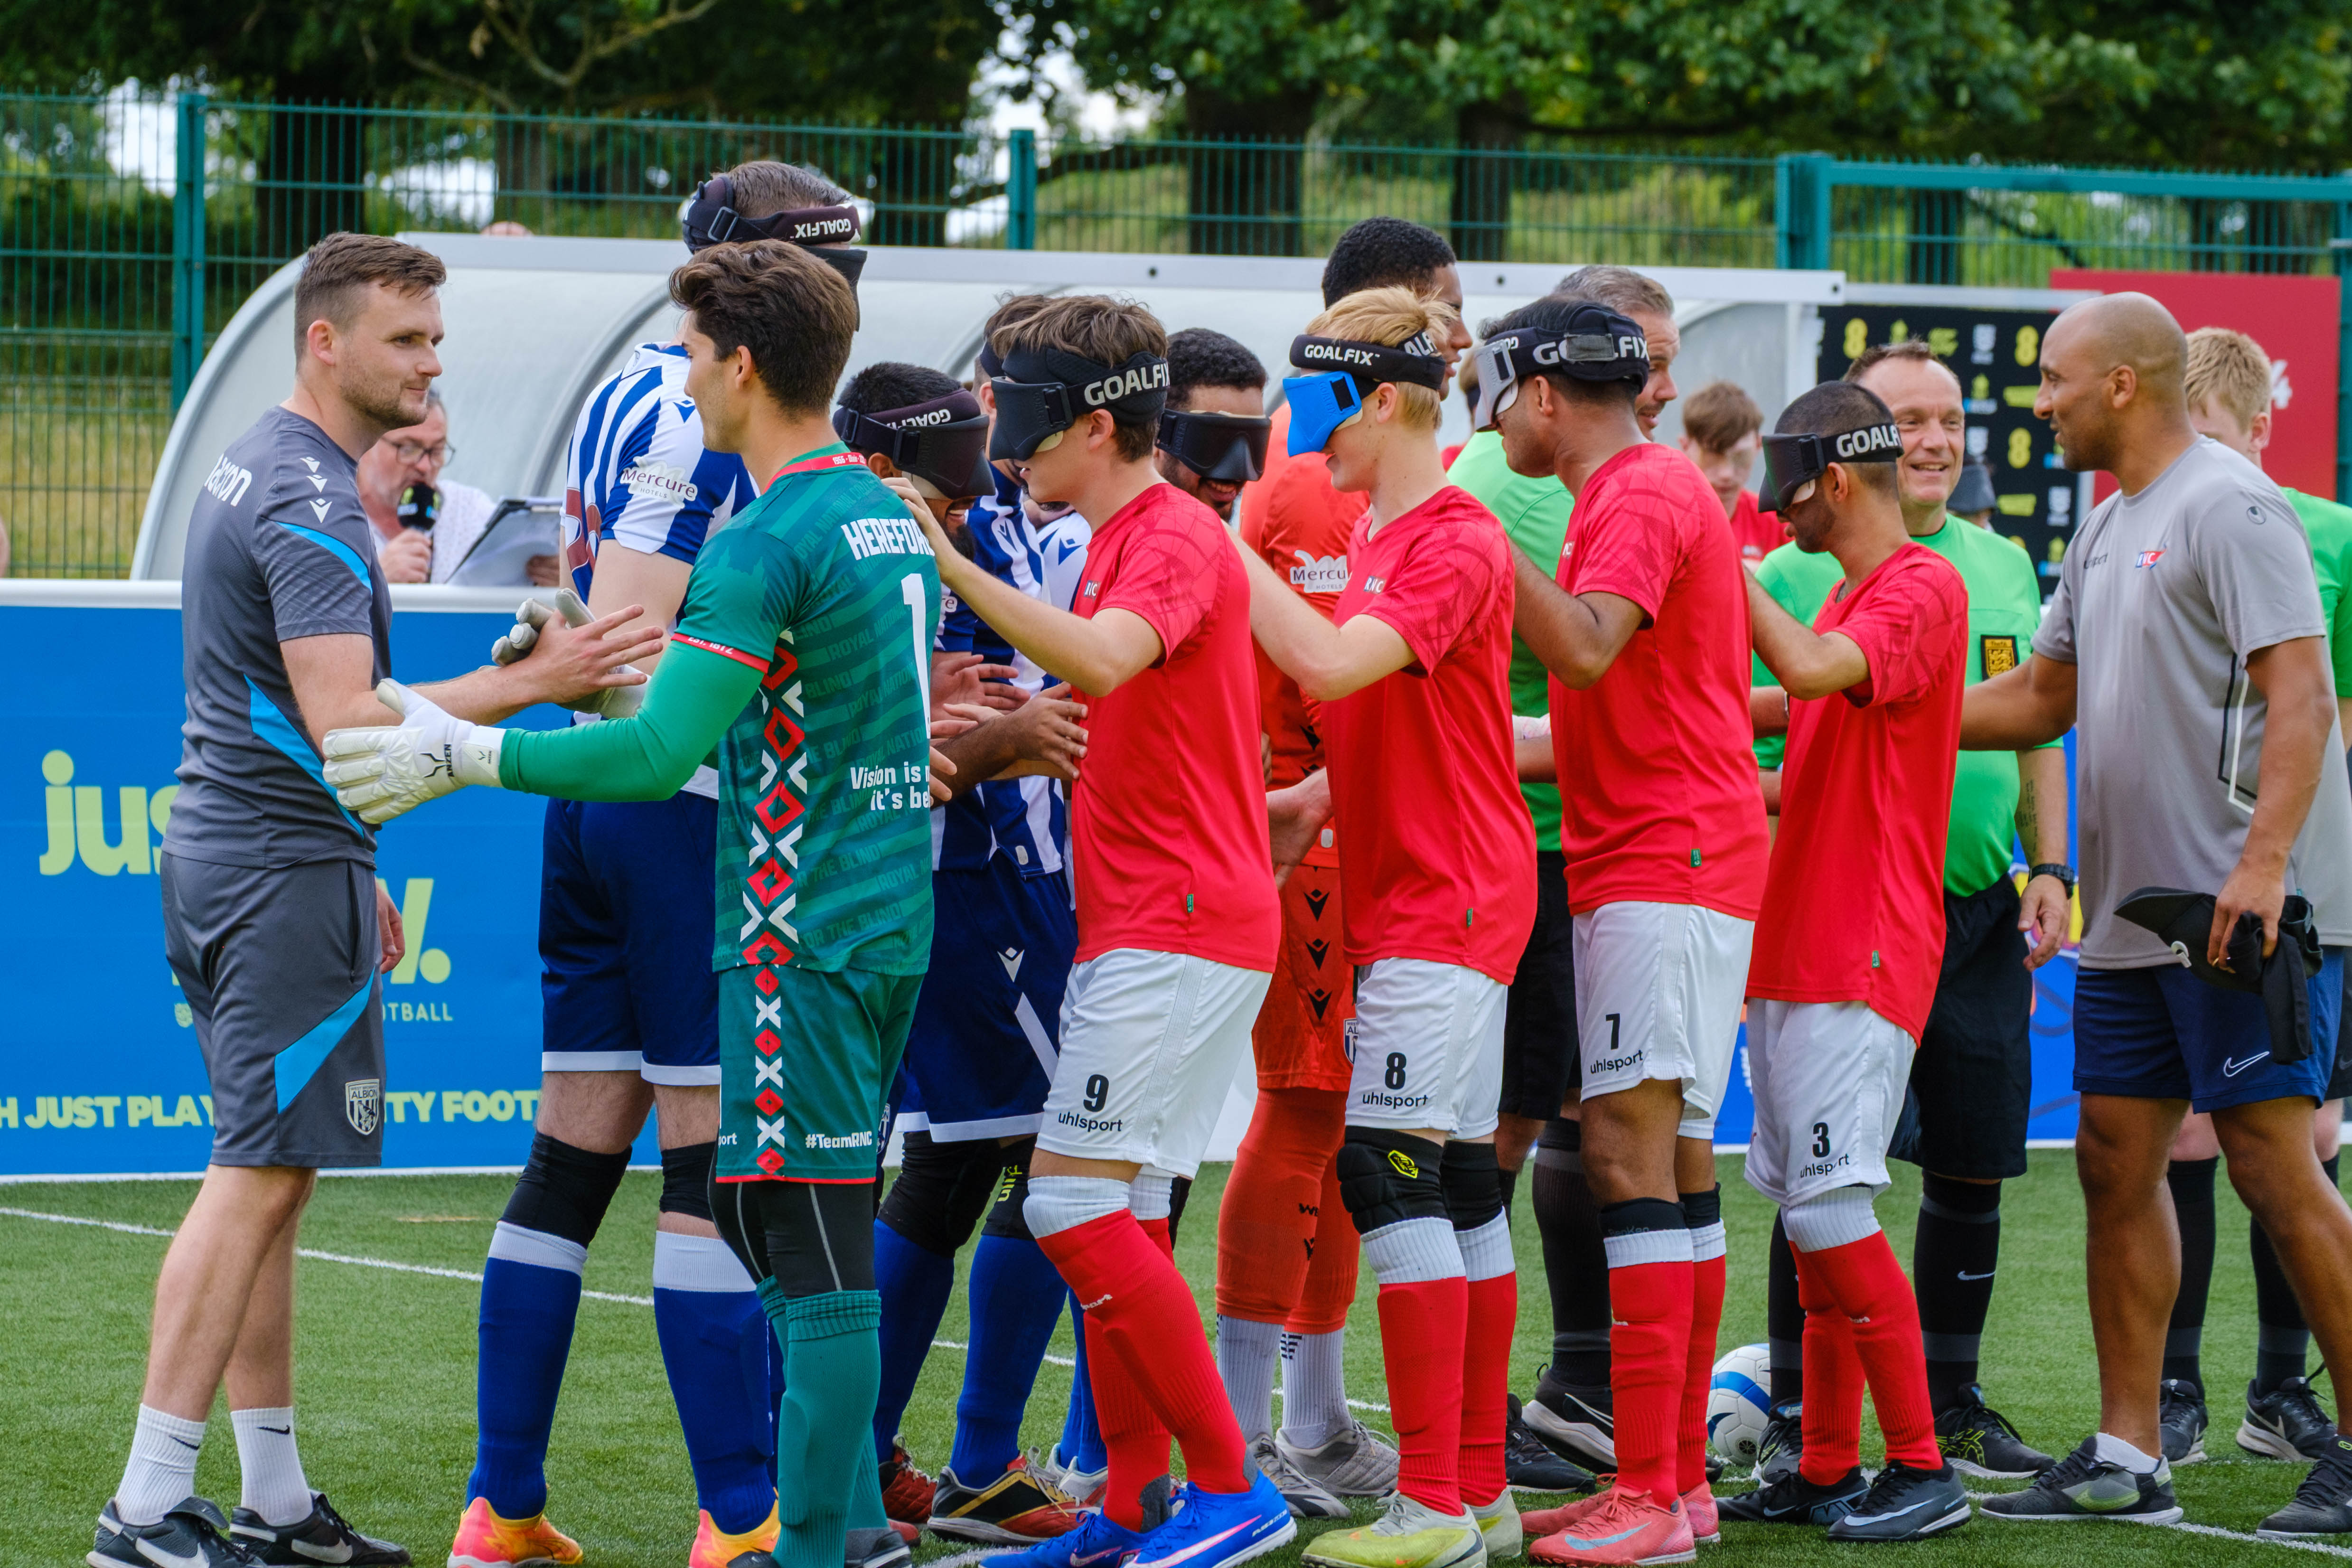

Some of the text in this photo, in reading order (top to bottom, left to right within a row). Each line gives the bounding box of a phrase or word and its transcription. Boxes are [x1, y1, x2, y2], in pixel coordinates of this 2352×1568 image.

[794, 218, 852, 238] GOALFIX
[1305, 344, 1374, 366] GOALFIX
[204, 453, 252, 507] acron
[623, 469, 695, 498] Mercure
[641, 488, 667, 498] HOTELS
[1293, 569, 1346, 582] Mercu
[901, 573, 931, 740] 1
[850, 761, 921, 789] Vision is
[870, 788, 903, 811] it's
[1385, 1052, 1407, 1090] 8
[1590, 1049, 1644, 1074] uhlsport
[1083, 1074, 1110, 1112] 9
[1362, 1092, 1429, 1109] uhlsport
[24, 1096, 121, 1129] JUST
[1058, 1111, 1123, 1133] uhlsport
[806, 1131, 872, 1149] #TeamRNC
[1812, 1122, 1830, 1157] 3
